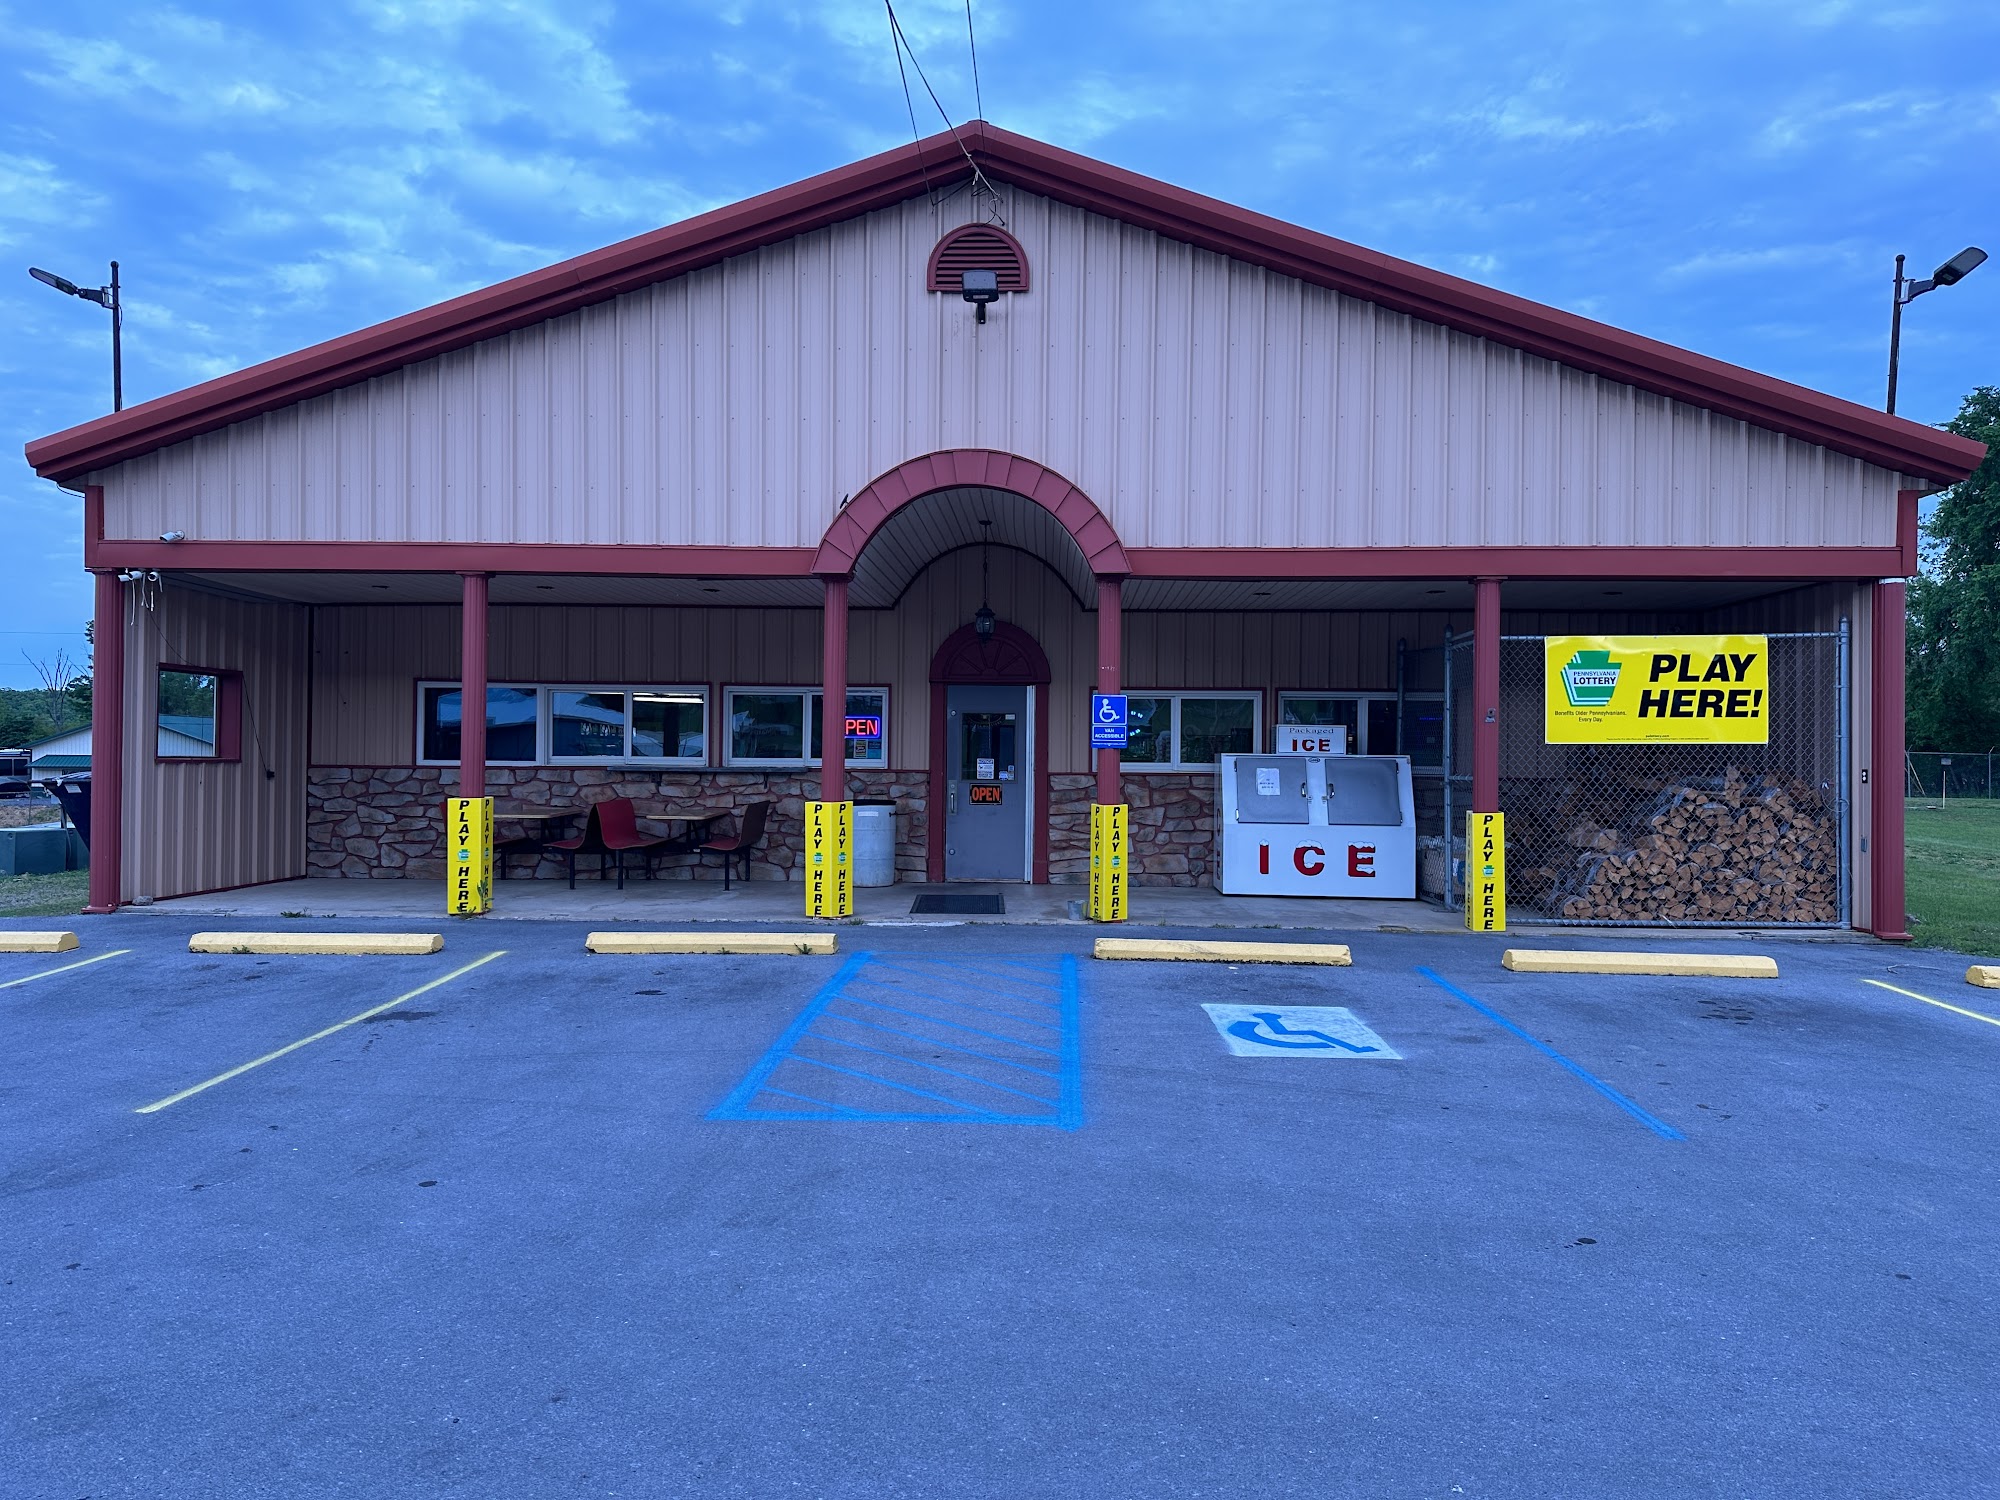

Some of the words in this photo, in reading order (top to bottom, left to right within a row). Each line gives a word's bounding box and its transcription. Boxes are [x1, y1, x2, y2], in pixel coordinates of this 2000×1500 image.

[1573, 677, 1617, 685] LOTTERY
[1649, 654, 1758, 682] PLAY
[1637, 689, 1763, 718] HERE!
[845, 719, 878, 736] PEN
[1288, 727, 1334, 735] Packaged
[1291, 737, 1331, 752] ICE
[971, 786, 1001, 802] OPEN
[458, 800, 470, 846] PLAY
[813, 804, 823, 849] PLAY
[838, 803, 847, 849] PLAY
[1112, 806, 1121, 852] PLAY
[1483, 815, 1494, 862] PLAY
[1258, 839, 1376, 878] ICE
[458, 866, 470, 913] HERE
[813, 870, 823, 915] HERE
[838, 869, 846, 915] HERE
[1111, 873, 1120, 919] HERE
[1483, 883, 1495, 930] HERE
